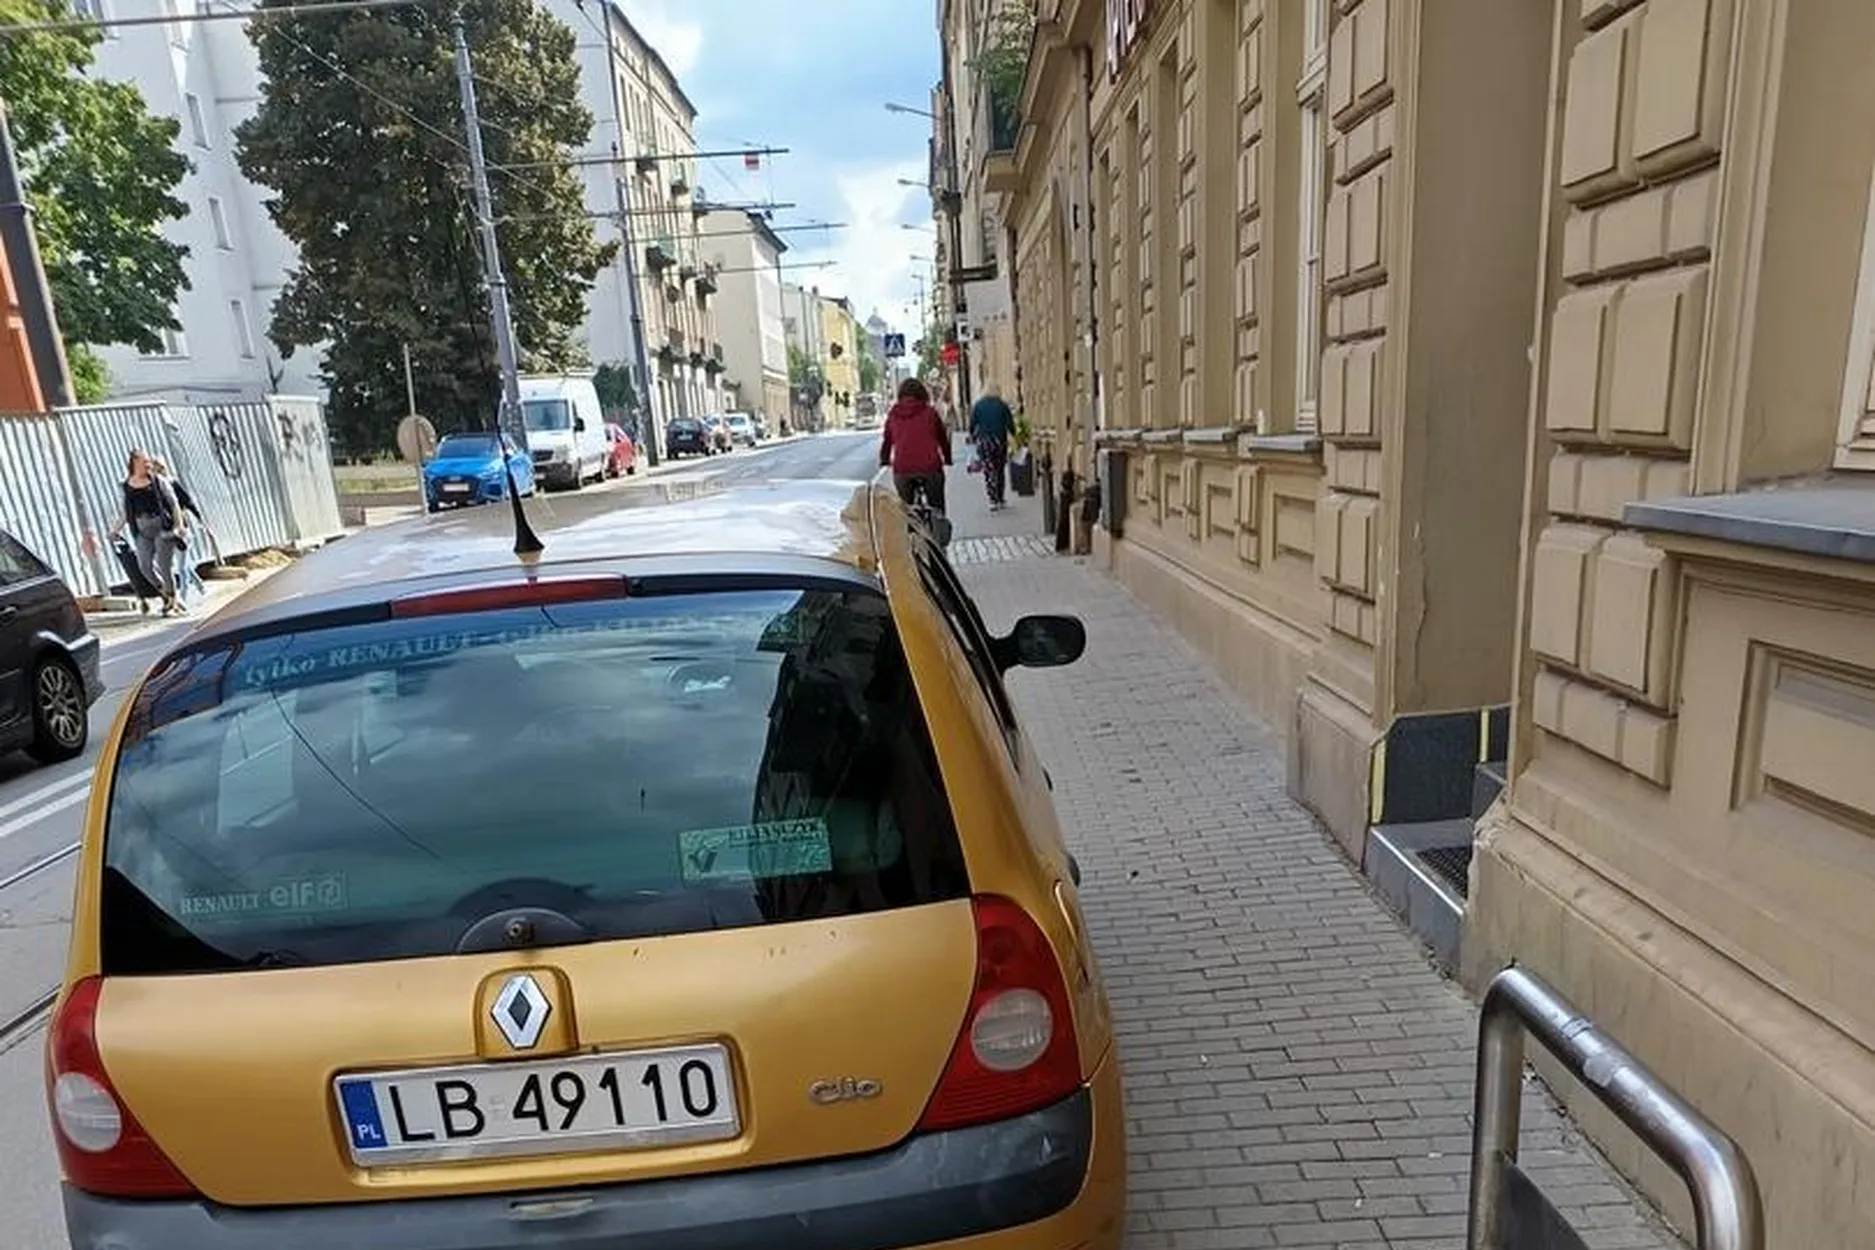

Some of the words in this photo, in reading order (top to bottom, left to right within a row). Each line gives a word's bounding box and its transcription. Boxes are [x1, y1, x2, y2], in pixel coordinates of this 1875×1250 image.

[327, 629, 478, 669] RENAULT
[181, 892, 261, 915] RENAULT
[389, 1079, 486, 1142] LB
[511, 1058, 718, 1132] 49110
[357, 1123, 383, 1141] PL
